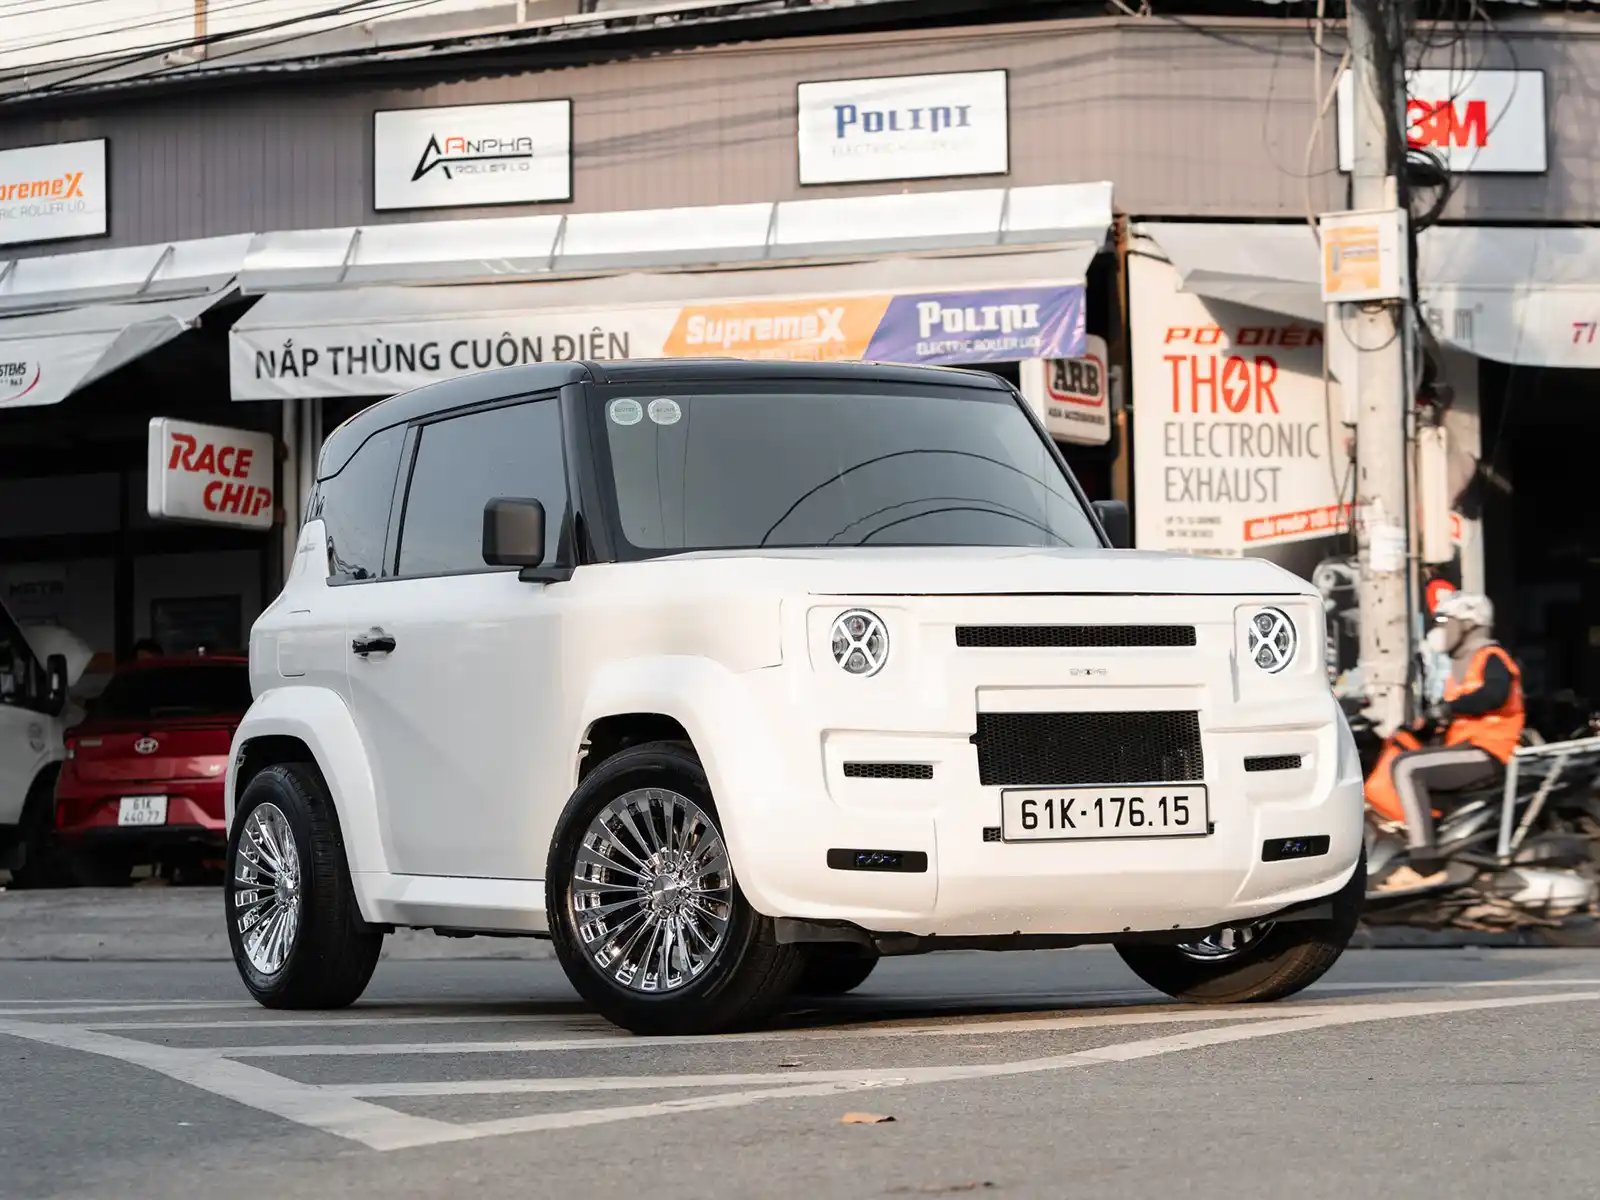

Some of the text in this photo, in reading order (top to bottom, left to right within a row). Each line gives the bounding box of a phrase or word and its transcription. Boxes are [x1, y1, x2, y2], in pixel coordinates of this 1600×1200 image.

[1406, 100, 1487, 147] 3M
[686, 307, 846, 346] SupremeX
[255, 338, 319, 379] NẮP
[326, 337, 440, 375] THÙNG
[1053, 359, 1098, 396] ARB
[1163, 355, 1279, 414] THOR
[168, 433, 253, 479] RACE
[1164, 421, 1320, 458] ELECTRONIC
[203, 481, 272, 517] CHIP
[1165, 466, 1281, 504] EXHAUST
[133, 798, 152, 810] 61K
